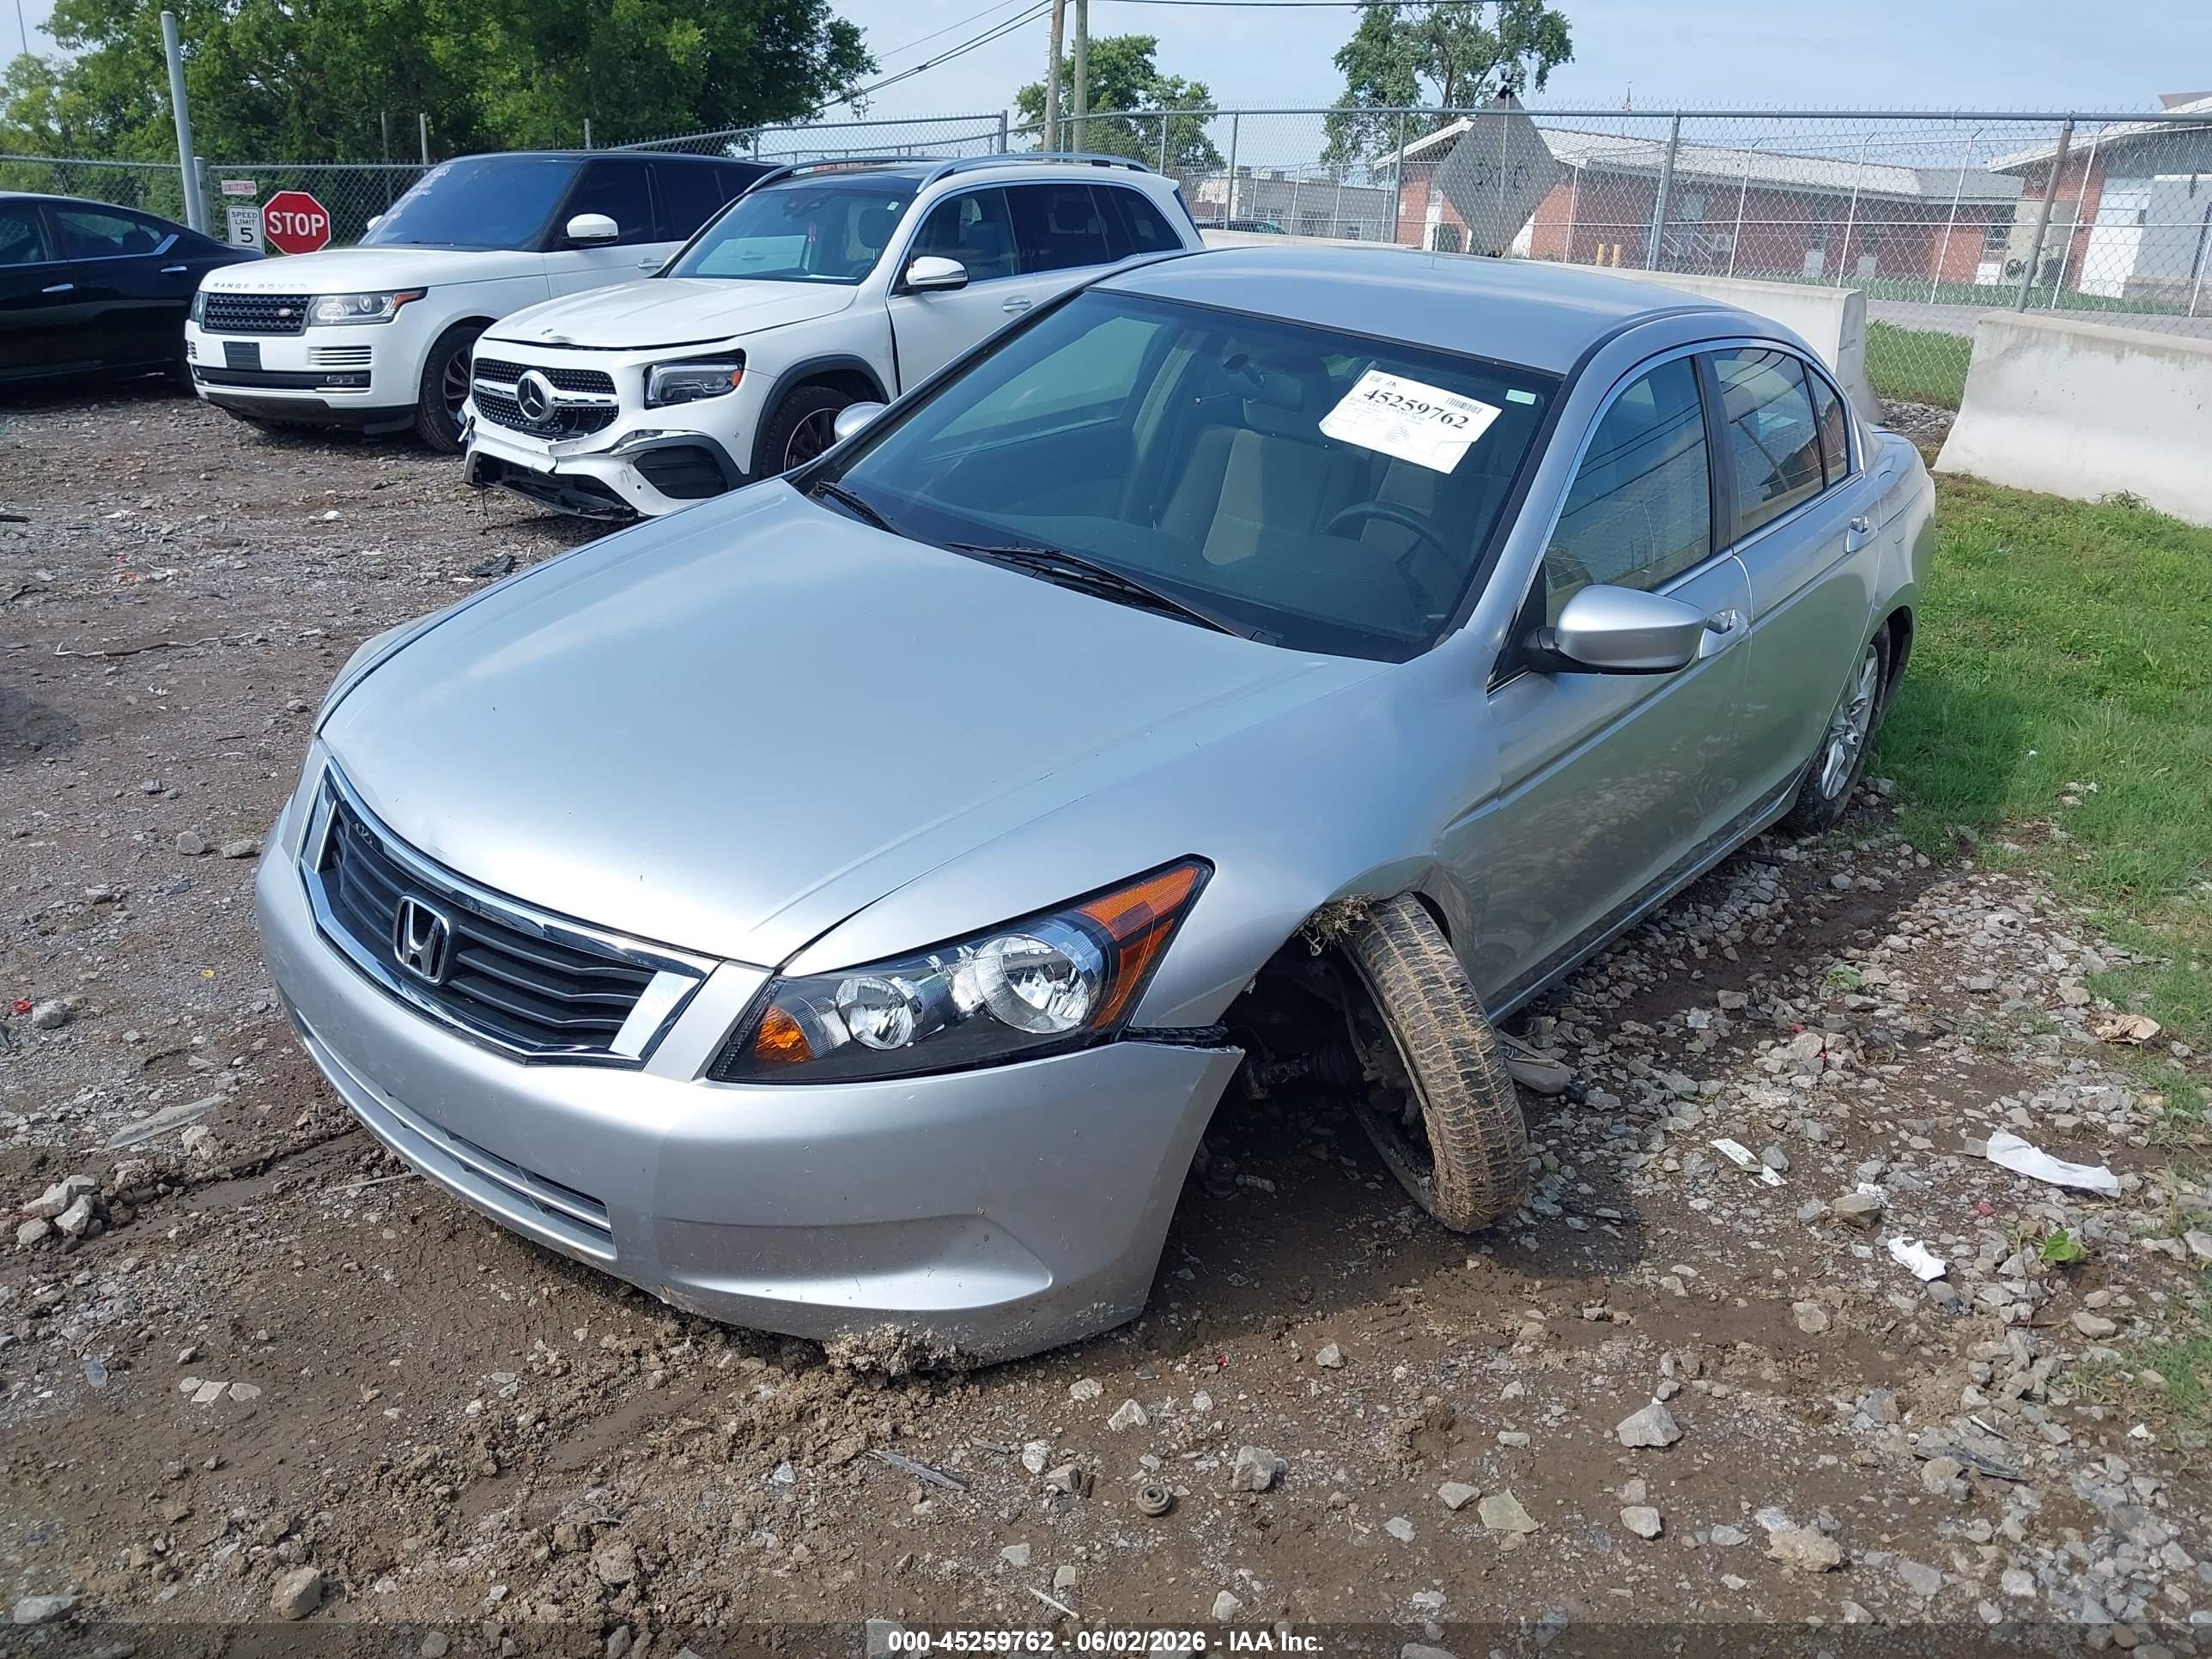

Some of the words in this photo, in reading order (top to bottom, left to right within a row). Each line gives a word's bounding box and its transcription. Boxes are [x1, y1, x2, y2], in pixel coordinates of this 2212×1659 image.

[240, 228, 253, 243] 5
[269, 211, 325, 236] STOP
[1364, 388, 1470, 429] 45259762
